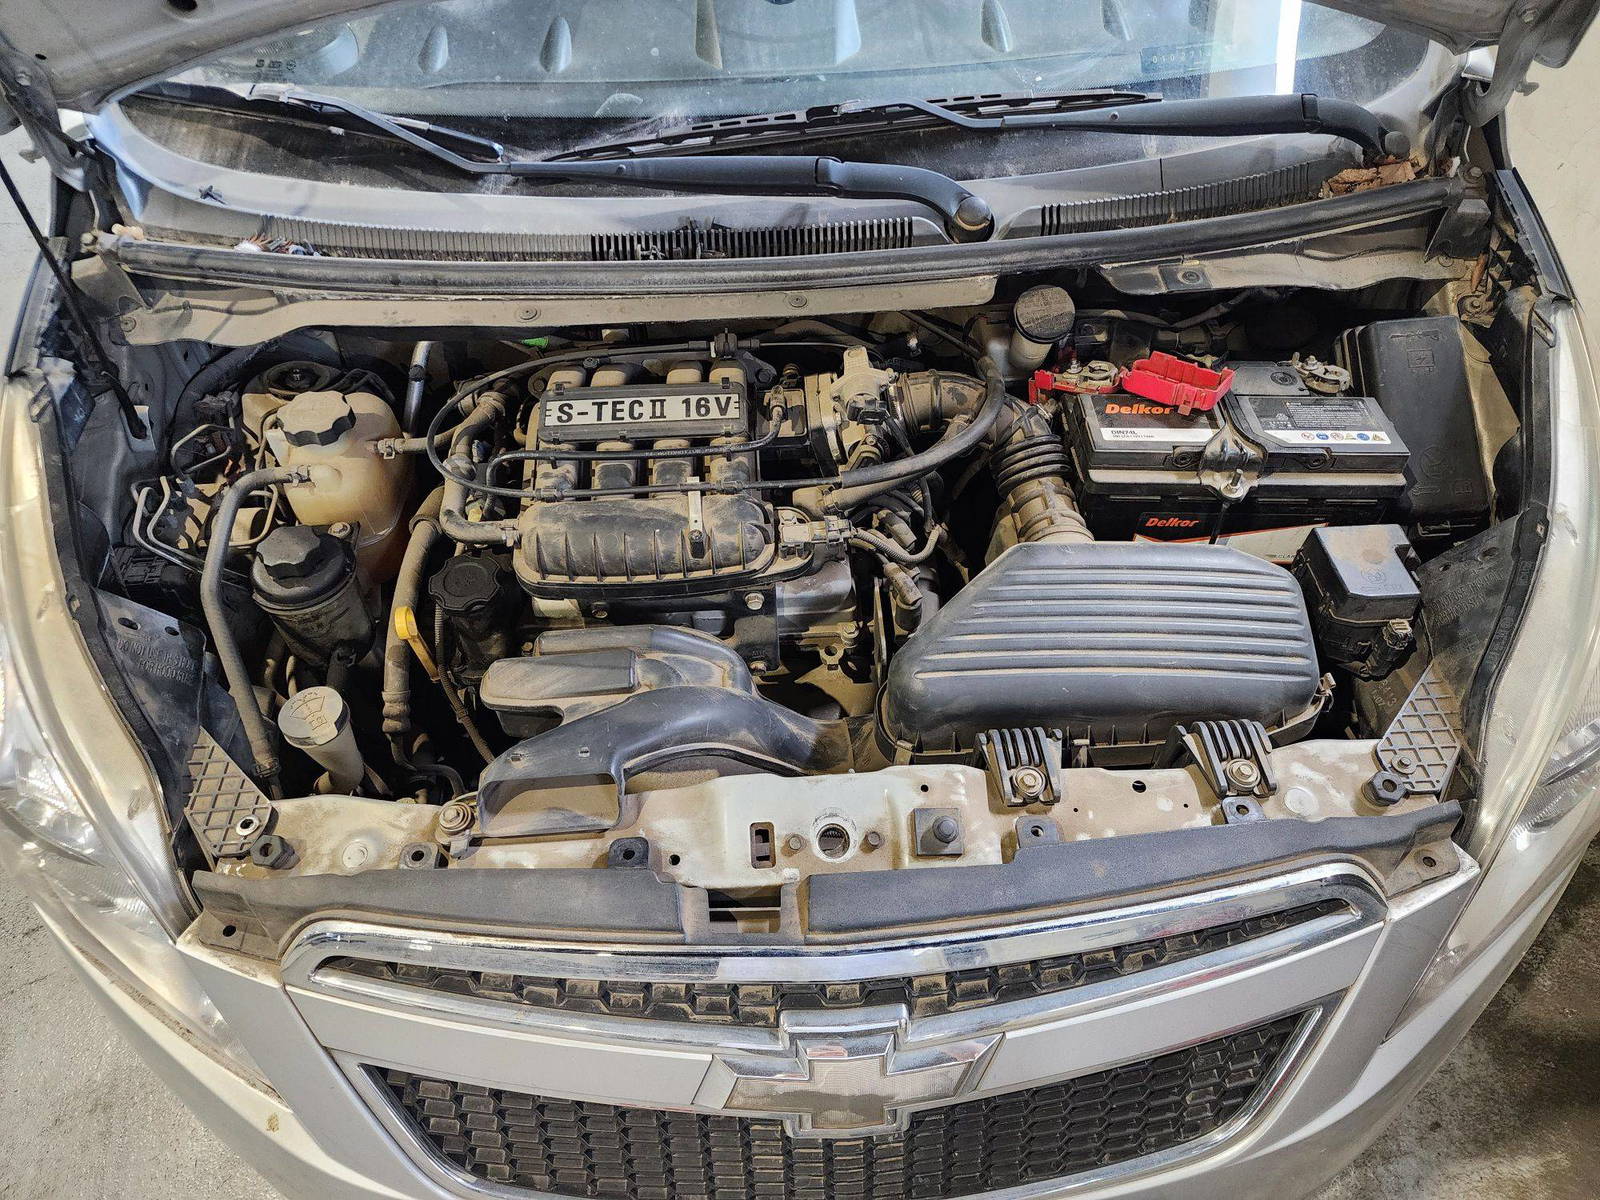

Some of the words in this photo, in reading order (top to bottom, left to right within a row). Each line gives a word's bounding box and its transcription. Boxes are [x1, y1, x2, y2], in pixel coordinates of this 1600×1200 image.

[682, 396, 732, 418] 16V
[1105, 403, 1174, 415] Delkor
[1145, 517, 1199, 527] Delkor
